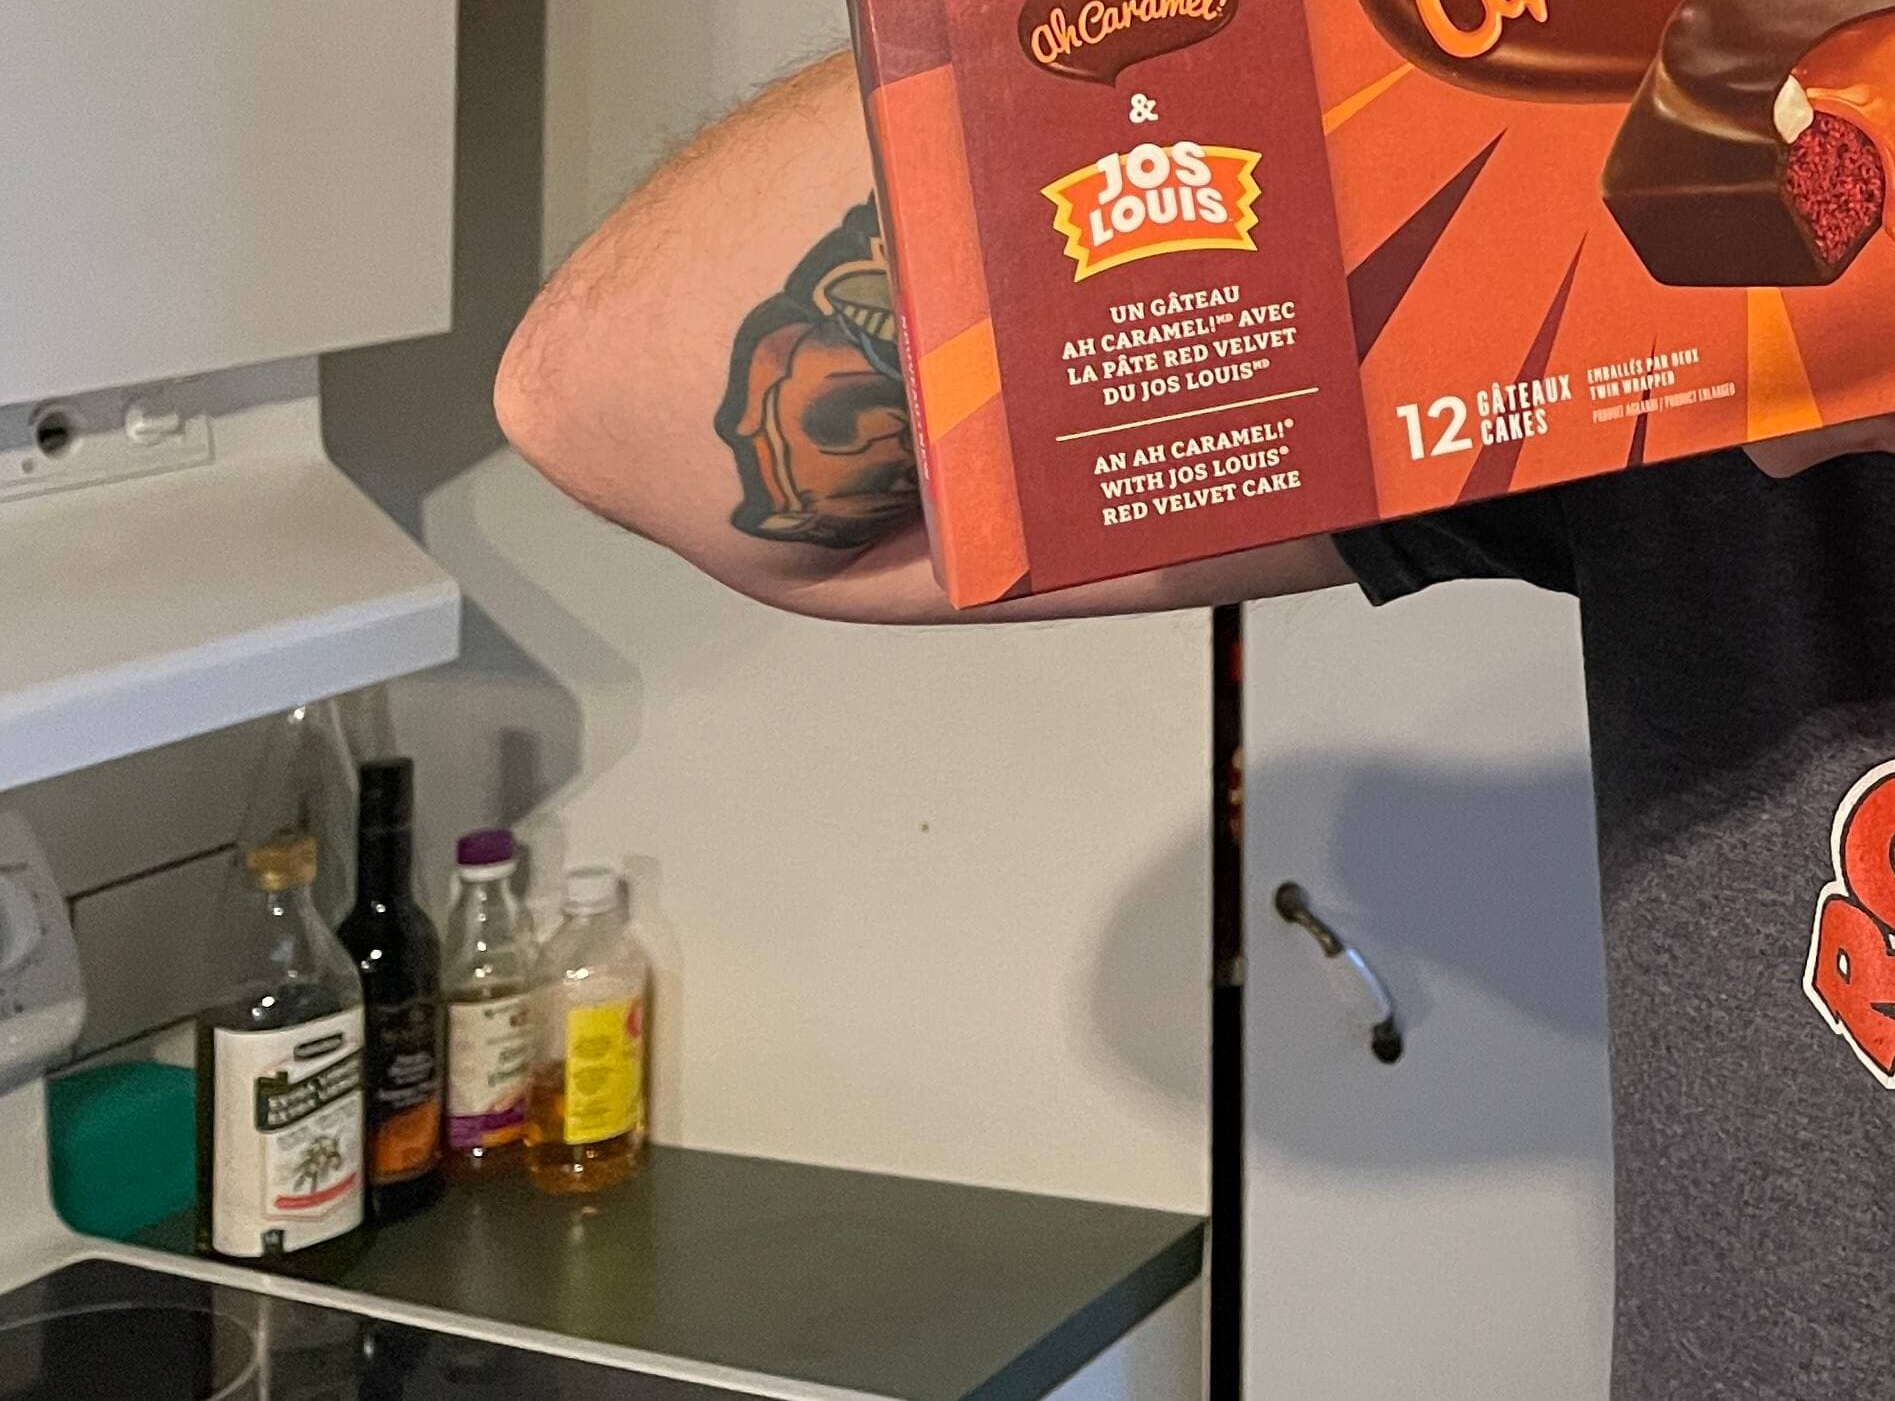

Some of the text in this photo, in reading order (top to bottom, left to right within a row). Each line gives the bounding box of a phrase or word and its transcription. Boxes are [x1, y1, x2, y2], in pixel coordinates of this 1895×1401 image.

[1129, 93, 1159, 123] &
[1096, 141, 1212, 205] JOS
[1090, 186, 1228, 246] LOUIS
[1110, 285, 1240, 324] UN GÂTEAU
[1062, 338, 1096, 360] AH
[1238, 301, 1296, 328] AVEC
[1067, 327, 1297, 386] LA PÂTE RED VELVET
[1587, 348, 1699, 384] EMBALLÉS PAR DEUX
[1103, 384, 1136, 406] DU
[1140, 375, 1181, 402] JOS
[1590, 371, 1675, 401] TWIN WRAPPED
[1396, 374, 1572, 461] 12 GÂTEAUX
[1480, 408, 1548, 446] CAKES
[1094, 452, 1126, 475] AN
[1132, 444, 1167, 467] AH
[1100, 471, 1164, 499] WITH
[1168, 463, 1208, 490] JOS
[1102, 470, 1301, 526] RED VELVET CAKE
